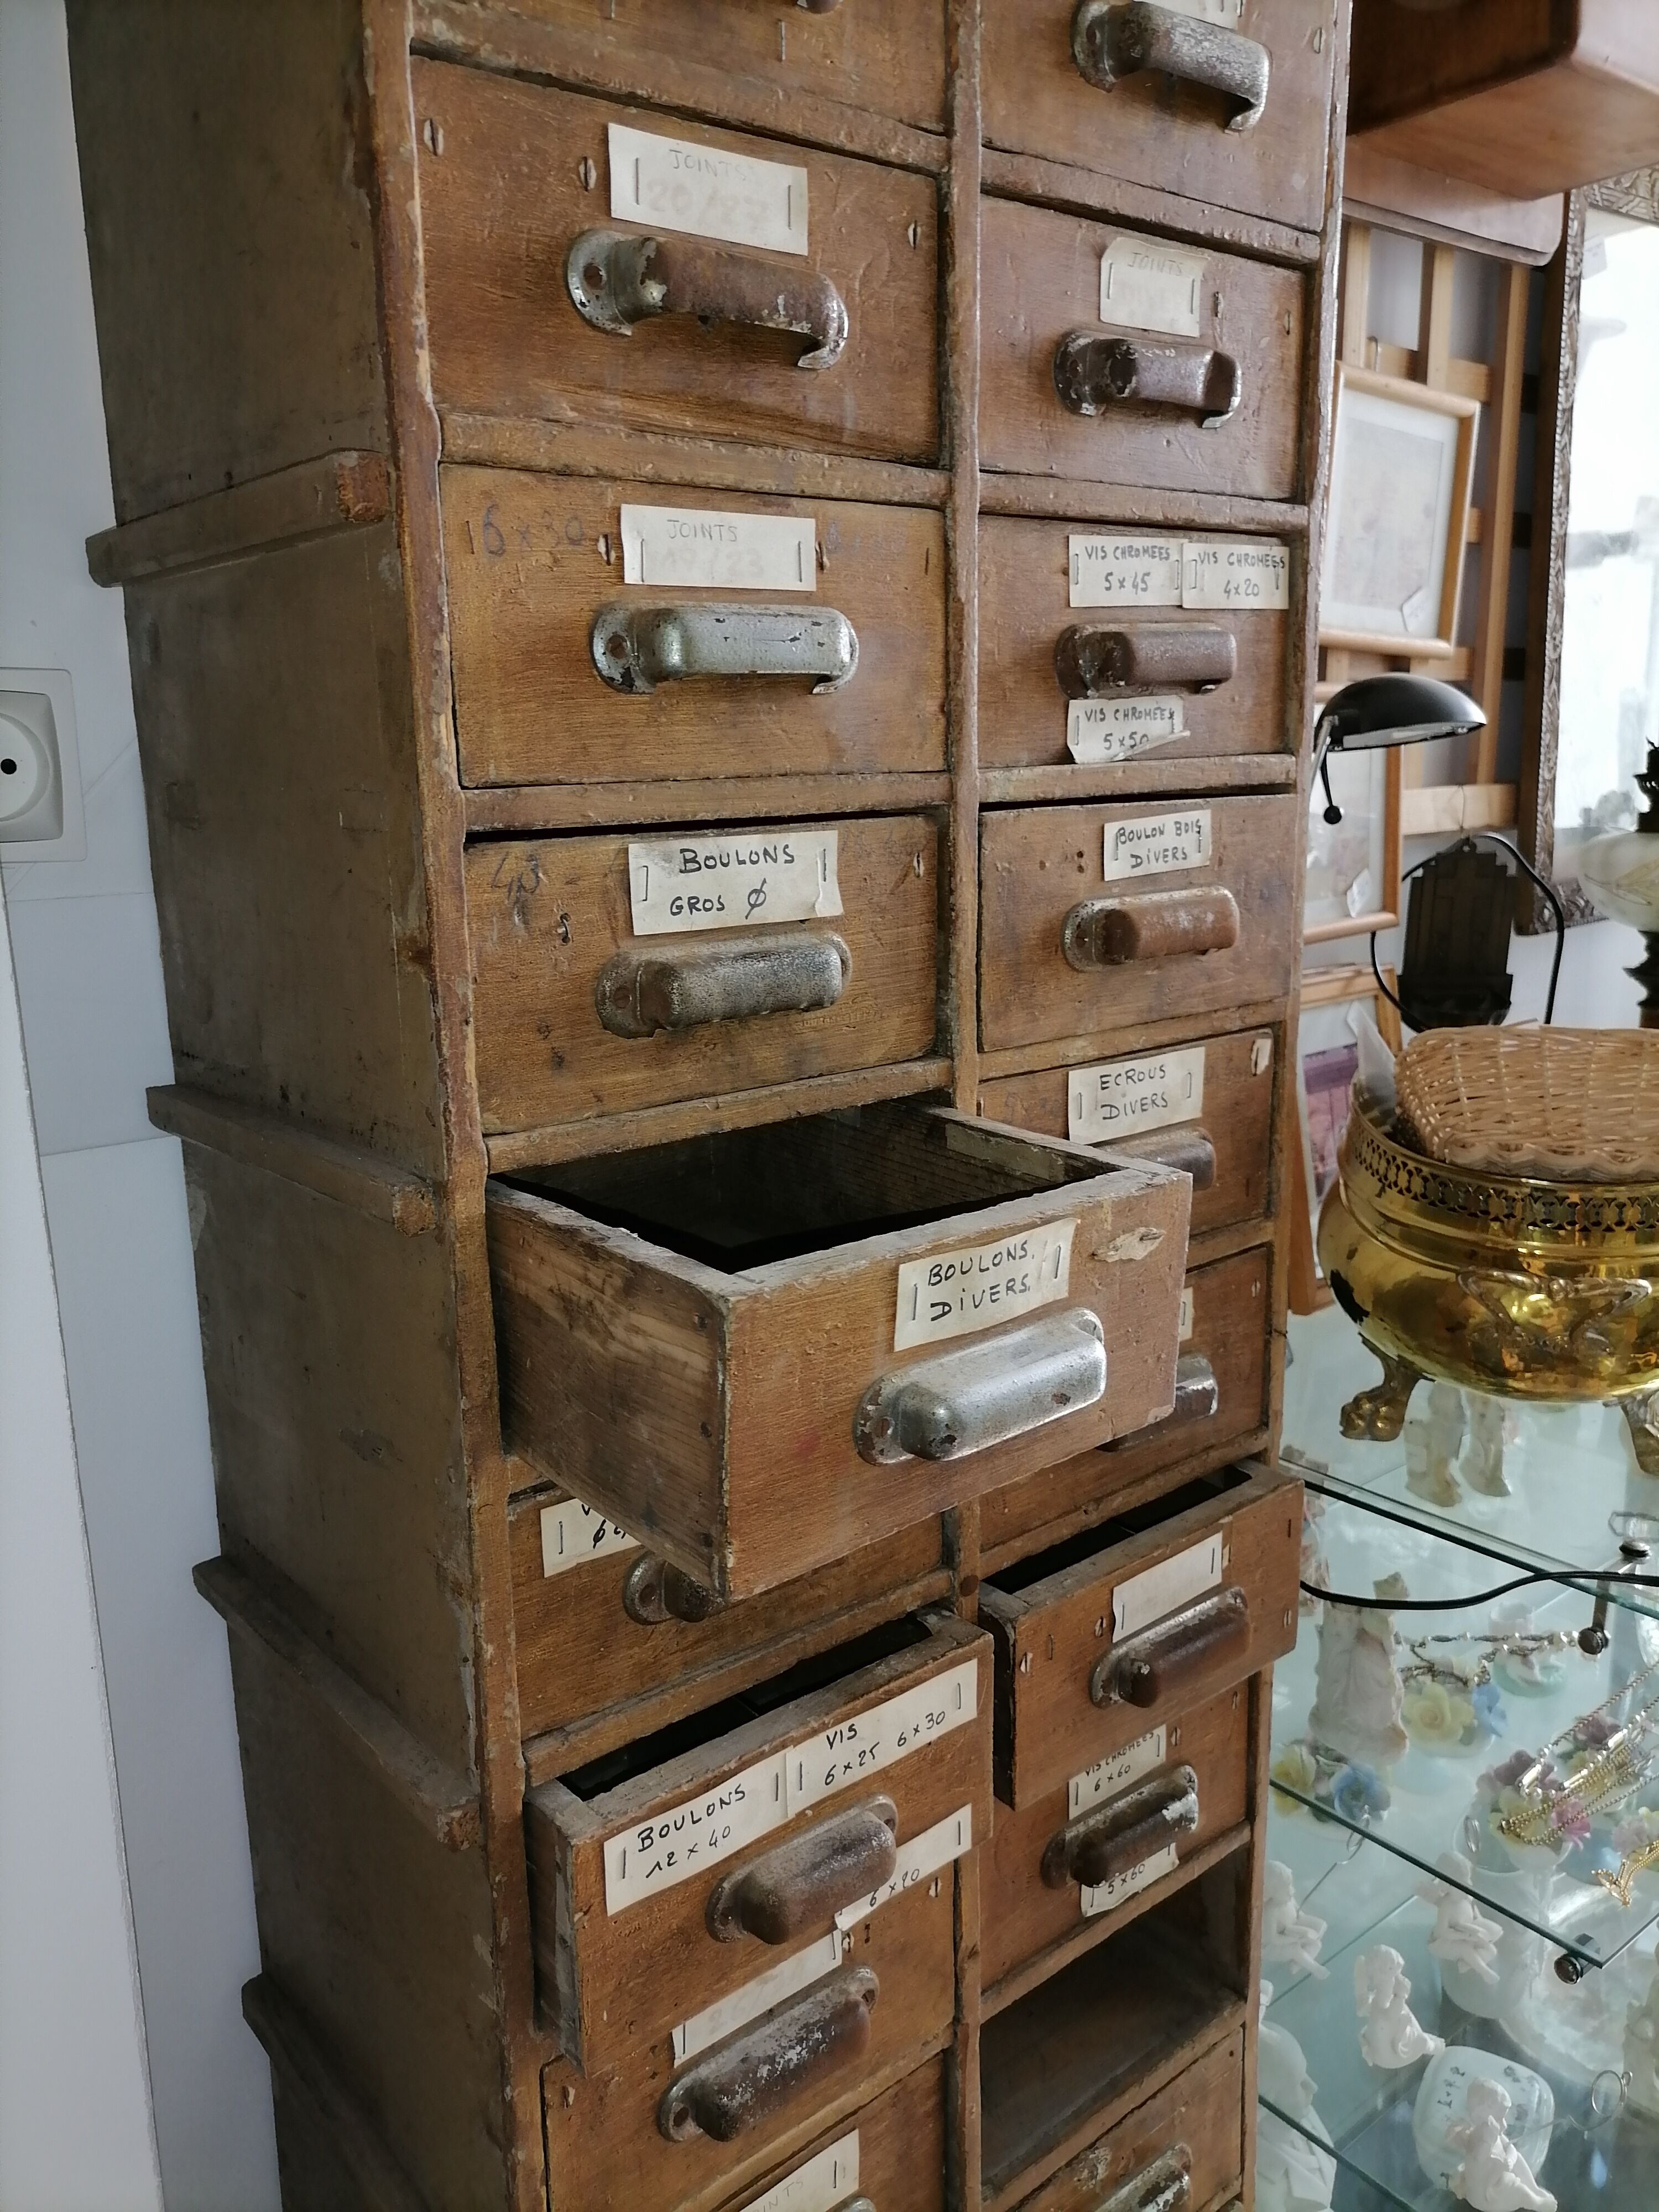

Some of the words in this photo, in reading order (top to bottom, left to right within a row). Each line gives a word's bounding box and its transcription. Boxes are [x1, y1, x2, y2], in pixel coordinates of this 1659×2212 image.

[669, 148, 748, 182] JOINTS
[1127, 252, 1185, 276] JOINTS
[666, 519, 738, 542] JOINTS
[1084, 545, 1107, 561] VIS
[1113, 545, 1170, 561] CHROMEES
[1198, 551, 1218, 565] VIS
[1084, 707, 1107, 723] VIS
[1117, 823, 1165, 845] BOULON
[1173, 818, 1202, 837] BOIS
[679, 843, 795, 874] BOULONS
[670, 894, 726, 916] GROS
[1099, 1064, 1166, 1091] ECROUS
[1100, 1091, 1168, 1120] DIVERS
[826, 1723, 858, 1750] VIS
[637, 1783, 746, 1853] BOULONS
